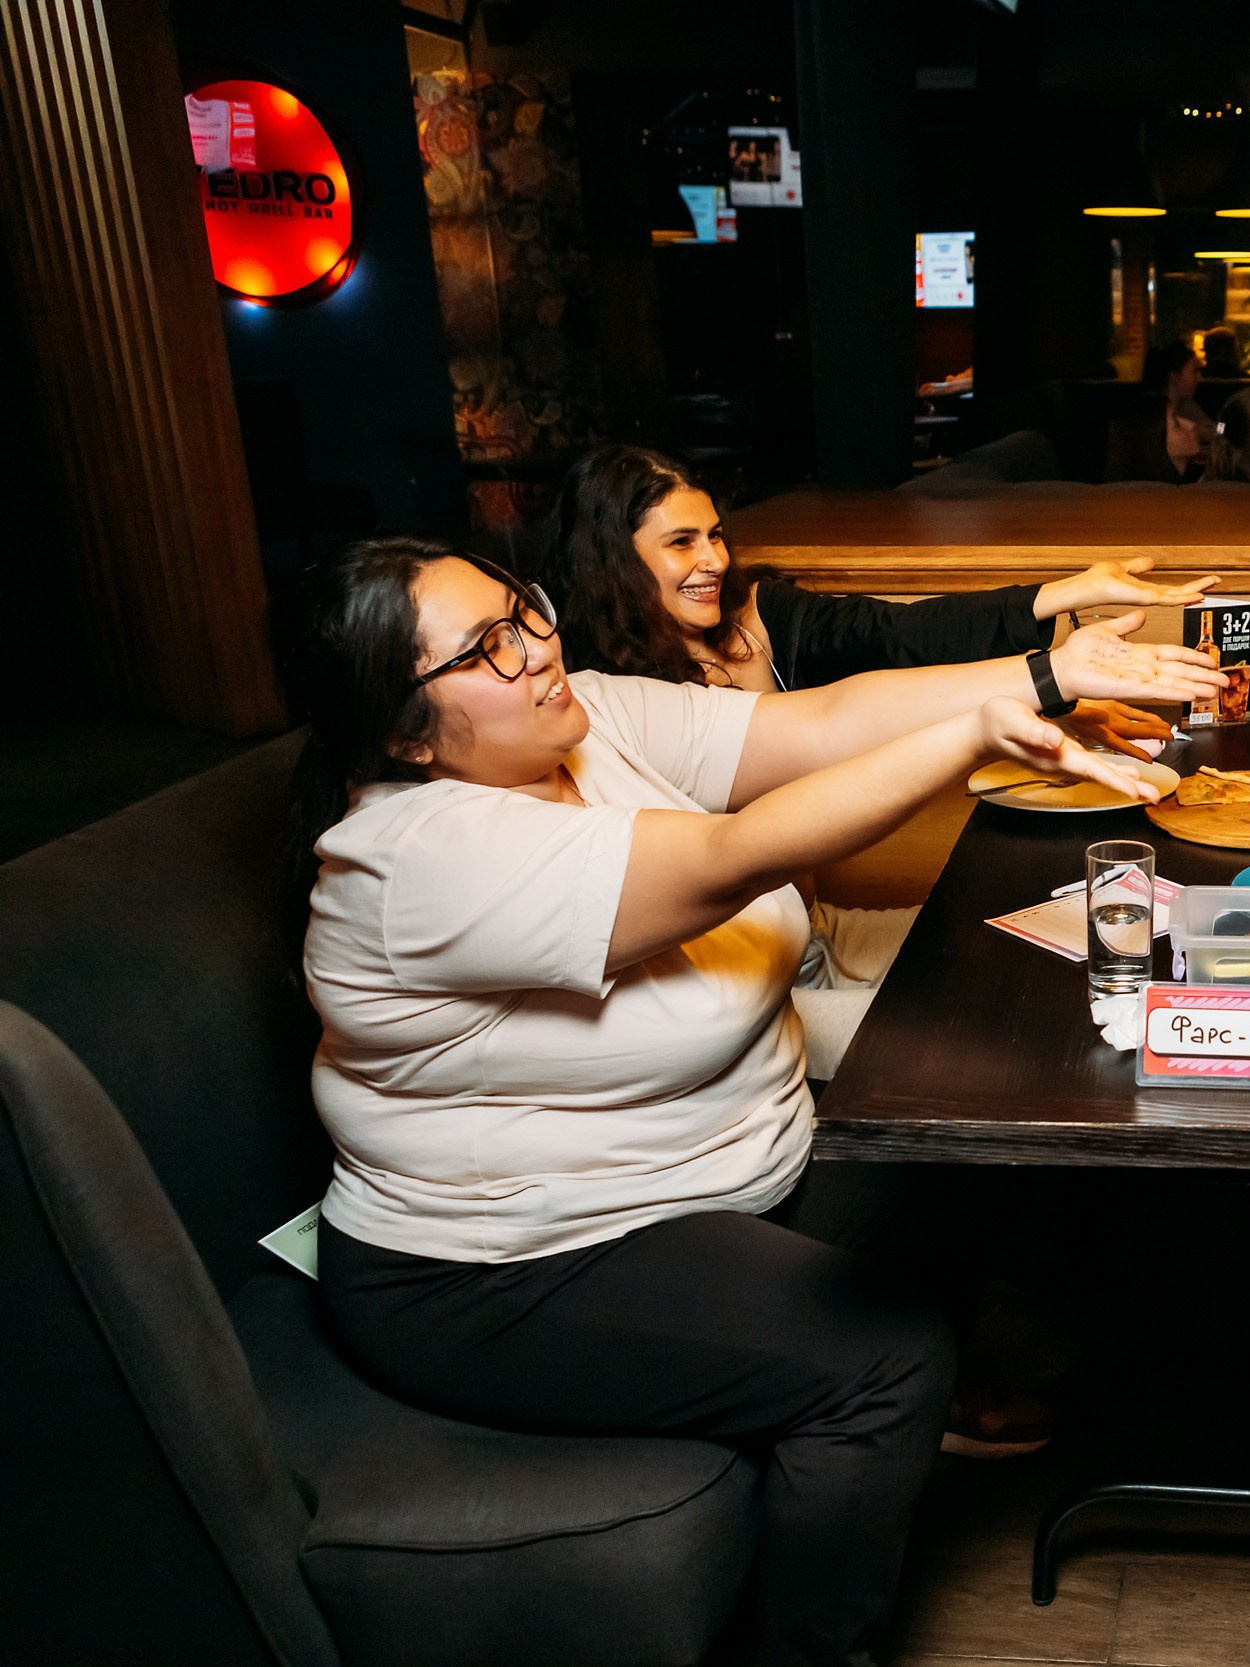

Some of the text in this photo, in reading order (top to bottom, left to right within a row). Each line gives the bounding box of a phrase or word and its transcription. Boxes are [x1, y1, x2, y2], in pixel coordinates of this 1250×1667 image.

[200, 168, 336, 205] EDRO
[304, 207, 333, 219] BAR
[1222, 611, 1250, 635] 3+2
[1227, 642, 1250, 651] ПОДАРОК
